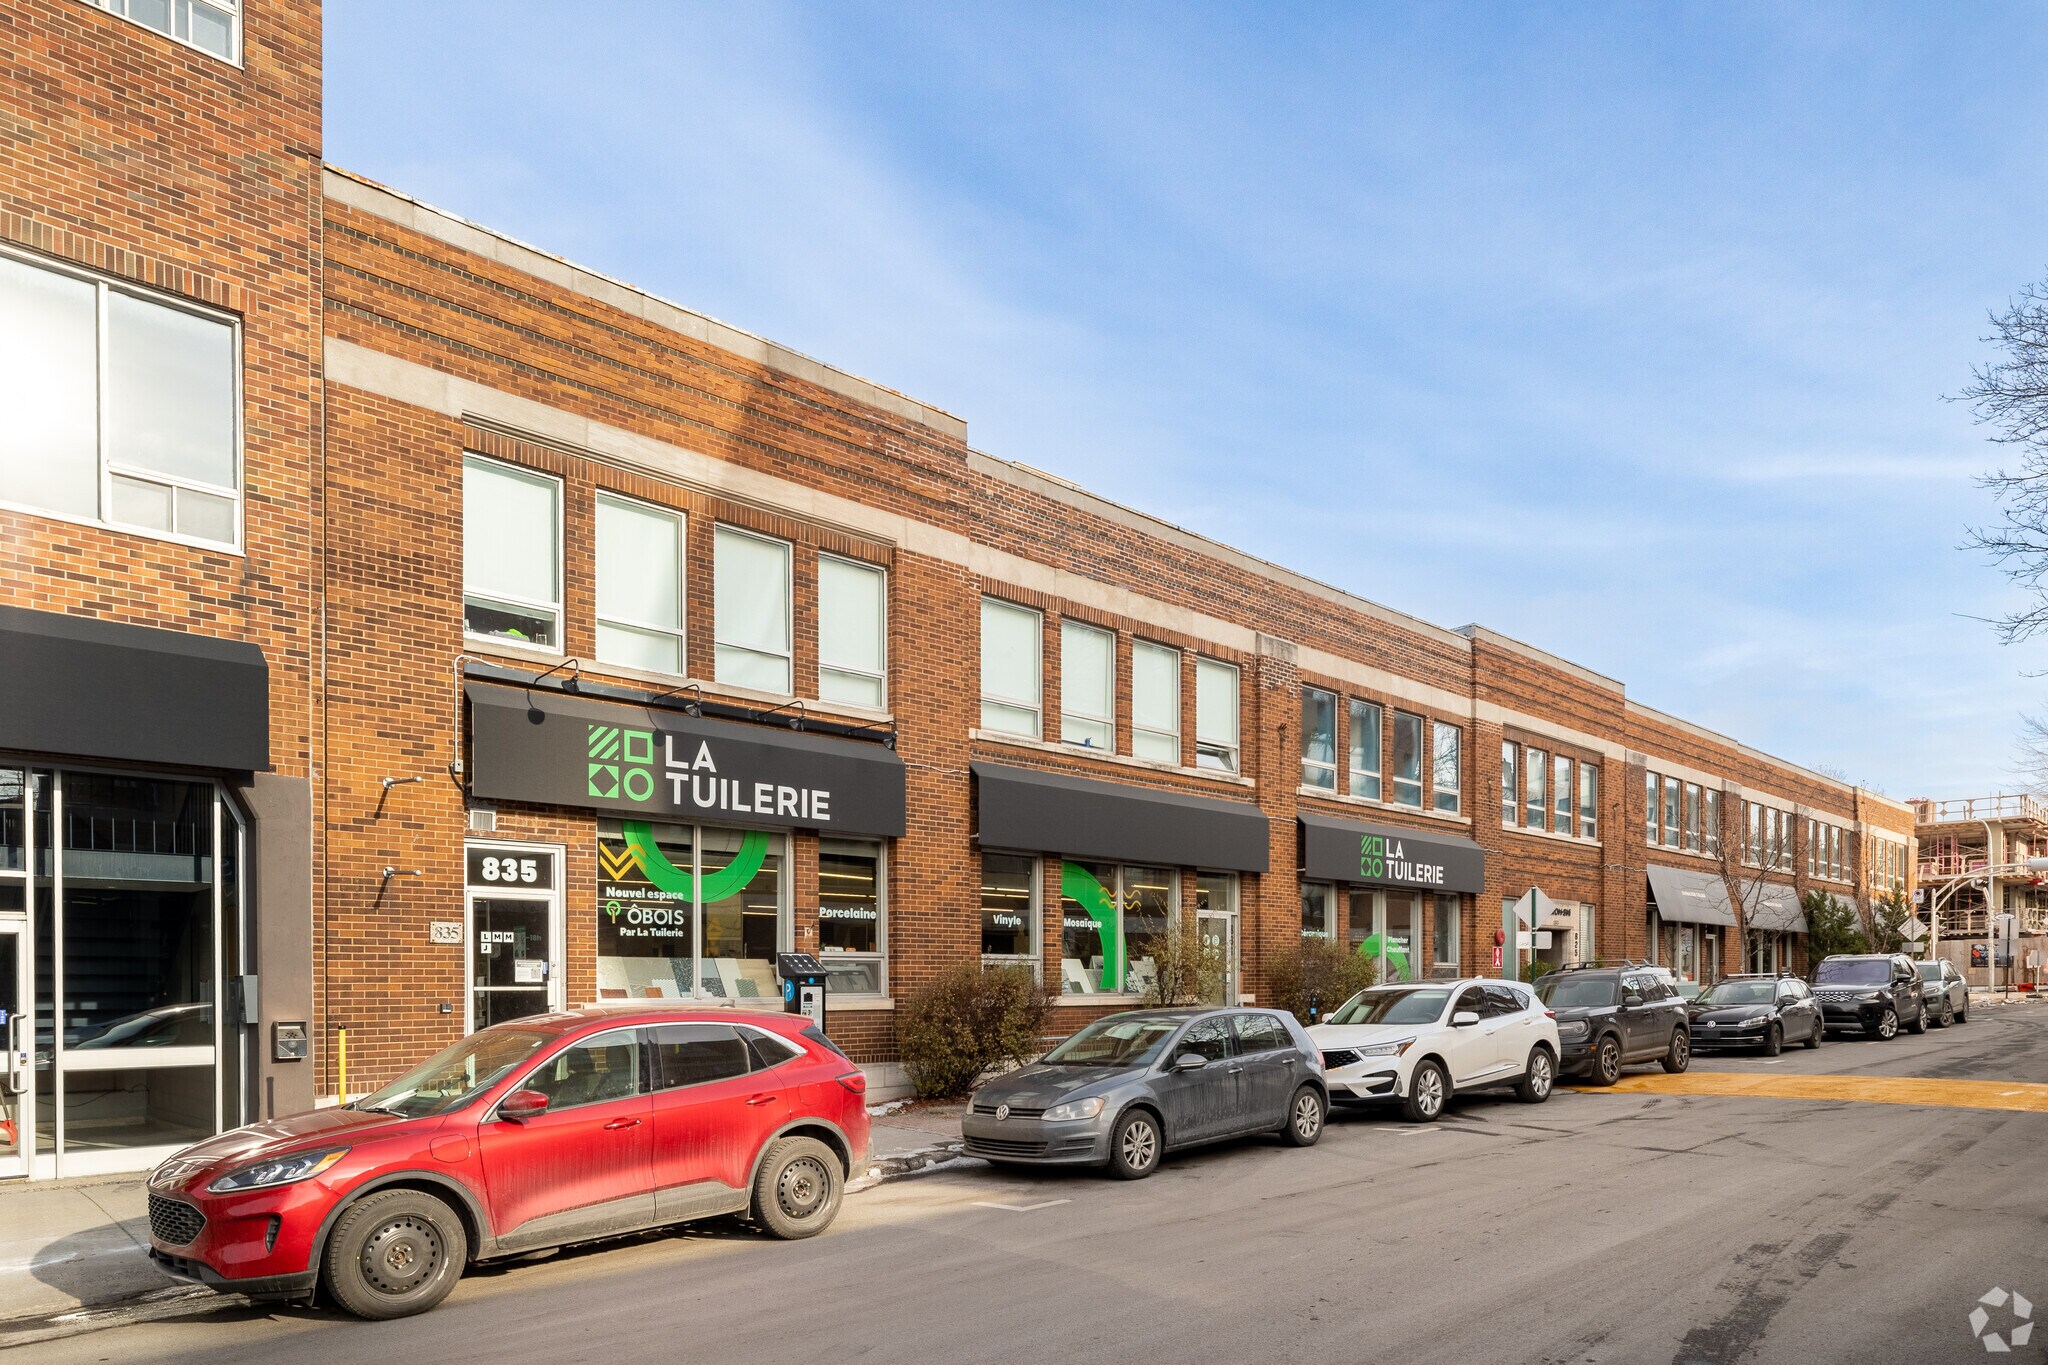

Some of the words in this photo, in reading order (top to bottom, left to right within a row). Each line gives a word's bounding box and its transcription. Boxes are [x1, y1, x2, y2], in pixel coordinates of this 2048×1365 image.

[666, 735, 717, 773] LA
[666, 772, 830, 821] TUILERIE
[1386, 839, 1404, 859] LA
[482, 857, 538, 883] 835
[1386, 860, 1443, 884] TUILERIE
[606, 887, 645, 898] Nouvel
[647, 891, 684, 902] espace
[627, 903, 684, 925] ÔBOIS
[820, 907, 877, 919] Porcelaine
[993, 914, 1021, 927] Vinyle
[434, 926, 459, 939] 835
[620, 928, 636, 936] Par
[637, 928, 648, 937] La
[650, 928, 684, 937] Tuilerie
[1063, 918, 1102, 930] Mosaïque
